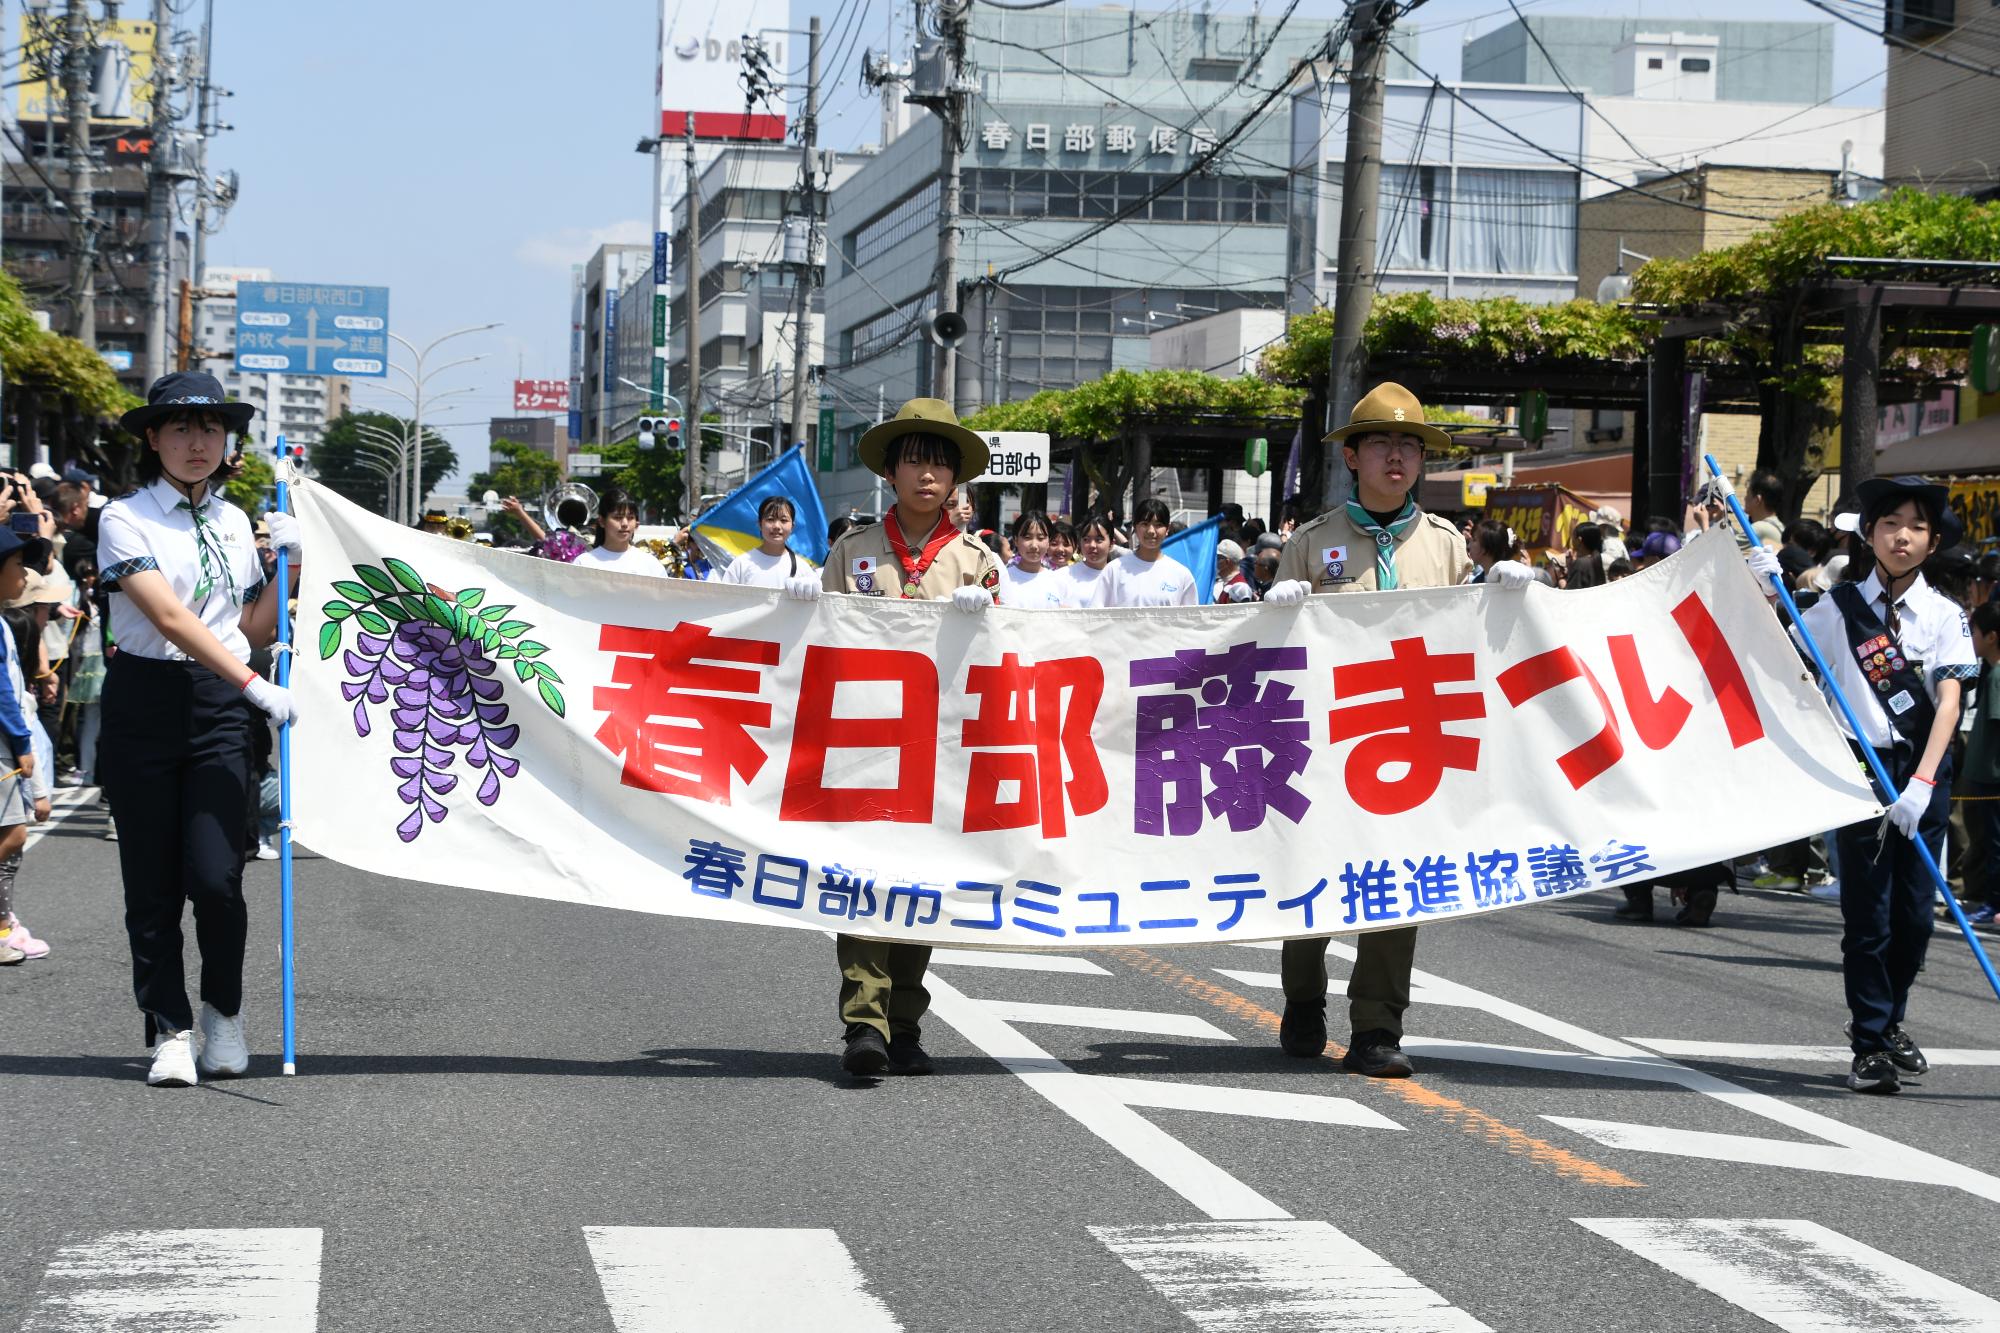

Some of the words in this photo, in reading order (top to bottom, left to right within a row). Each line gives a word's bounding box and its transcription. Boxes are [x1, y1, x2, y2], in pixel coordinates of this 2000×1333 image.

[981, 121, 1220, 157] 春日部郵便局
[263, 287, 364, 307] 春日部駅西口
[239, 332, 274, 349] 内牧
[349, 336, 384, 354] 武里
[983, 451, 1041, 477] 日部中
[593, 590, 1764, 839] 春日部藤まつり
[682, 838, 1657, 938] 春日部市コミュニティ推進協議会
